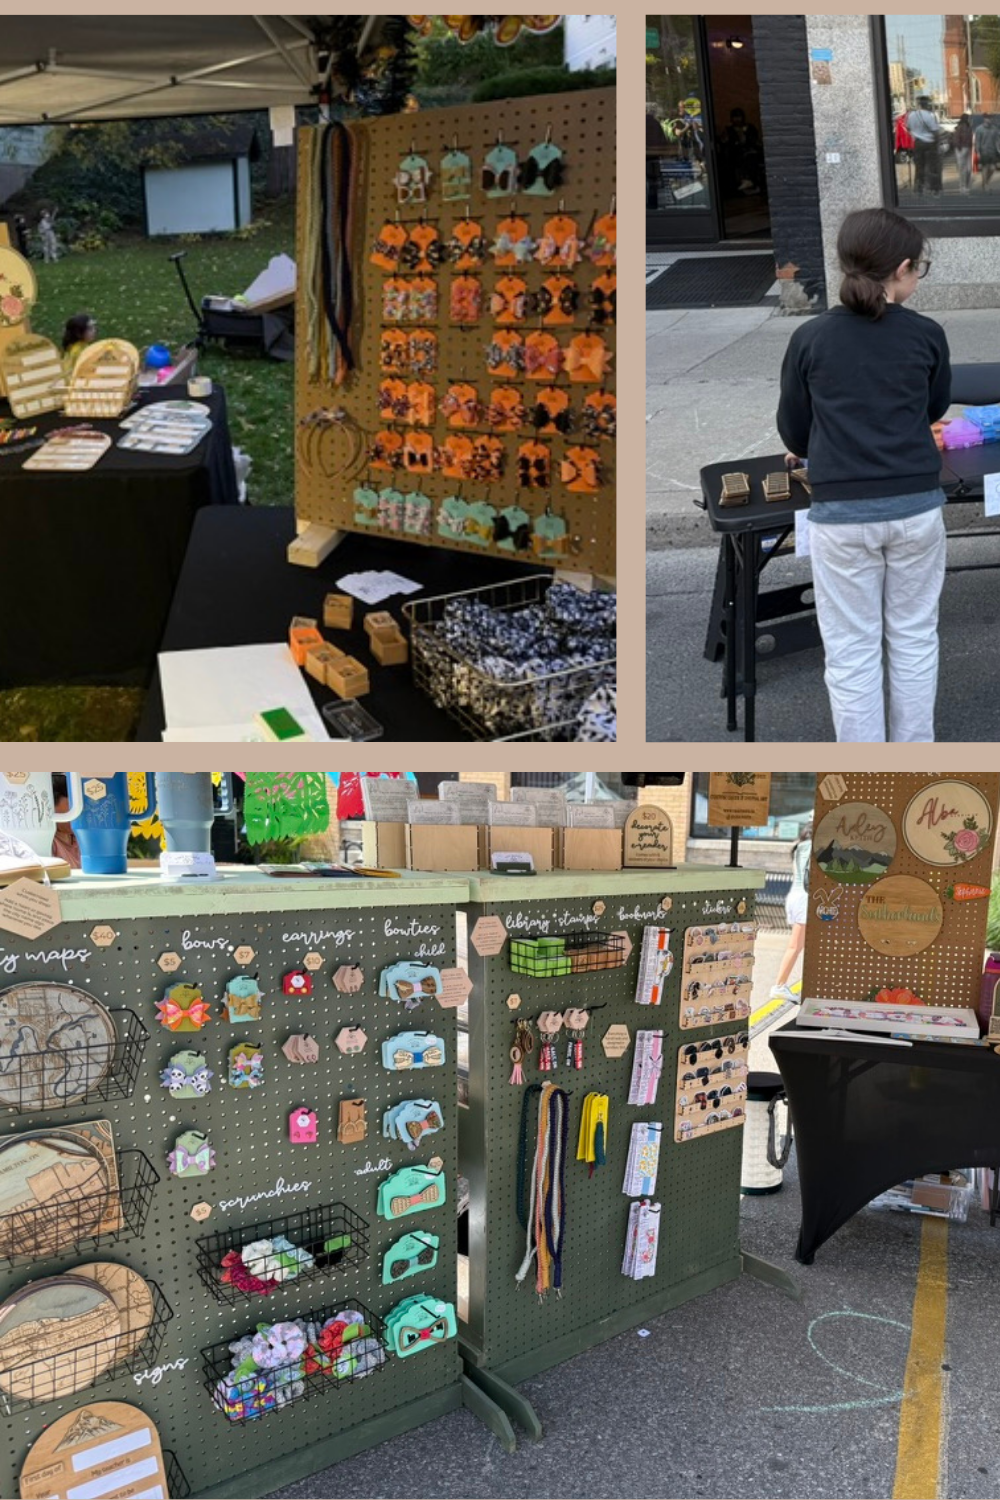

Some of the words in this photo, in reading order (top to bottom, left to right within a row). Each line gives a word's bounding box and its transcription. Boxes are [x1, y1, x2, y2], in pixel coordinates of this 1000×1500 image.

[86, 784, 104, 796] $25
[642, 812, 657, 820] $20
[866, 895, 886, 904] THE
[384, 918, 441, 937] bowties
[92, 931, 115, 940] $40
[182, 930, 230, 951] bows
[282, 928, 356, 946] earrings
[238, 951, 251, 959] $7
[414, 943, 447, 958] child
[25, 948, 92, 971] maps
[163, 958, 176, 966] $5
[306, 957, 321, 965] $10
[353, 1157, 394, 1177] adult
[218, 1177, 313, 1212] scrunchies
[133, 1355, 190, 1386] signs
[42, 1468, 54, 1479] day
